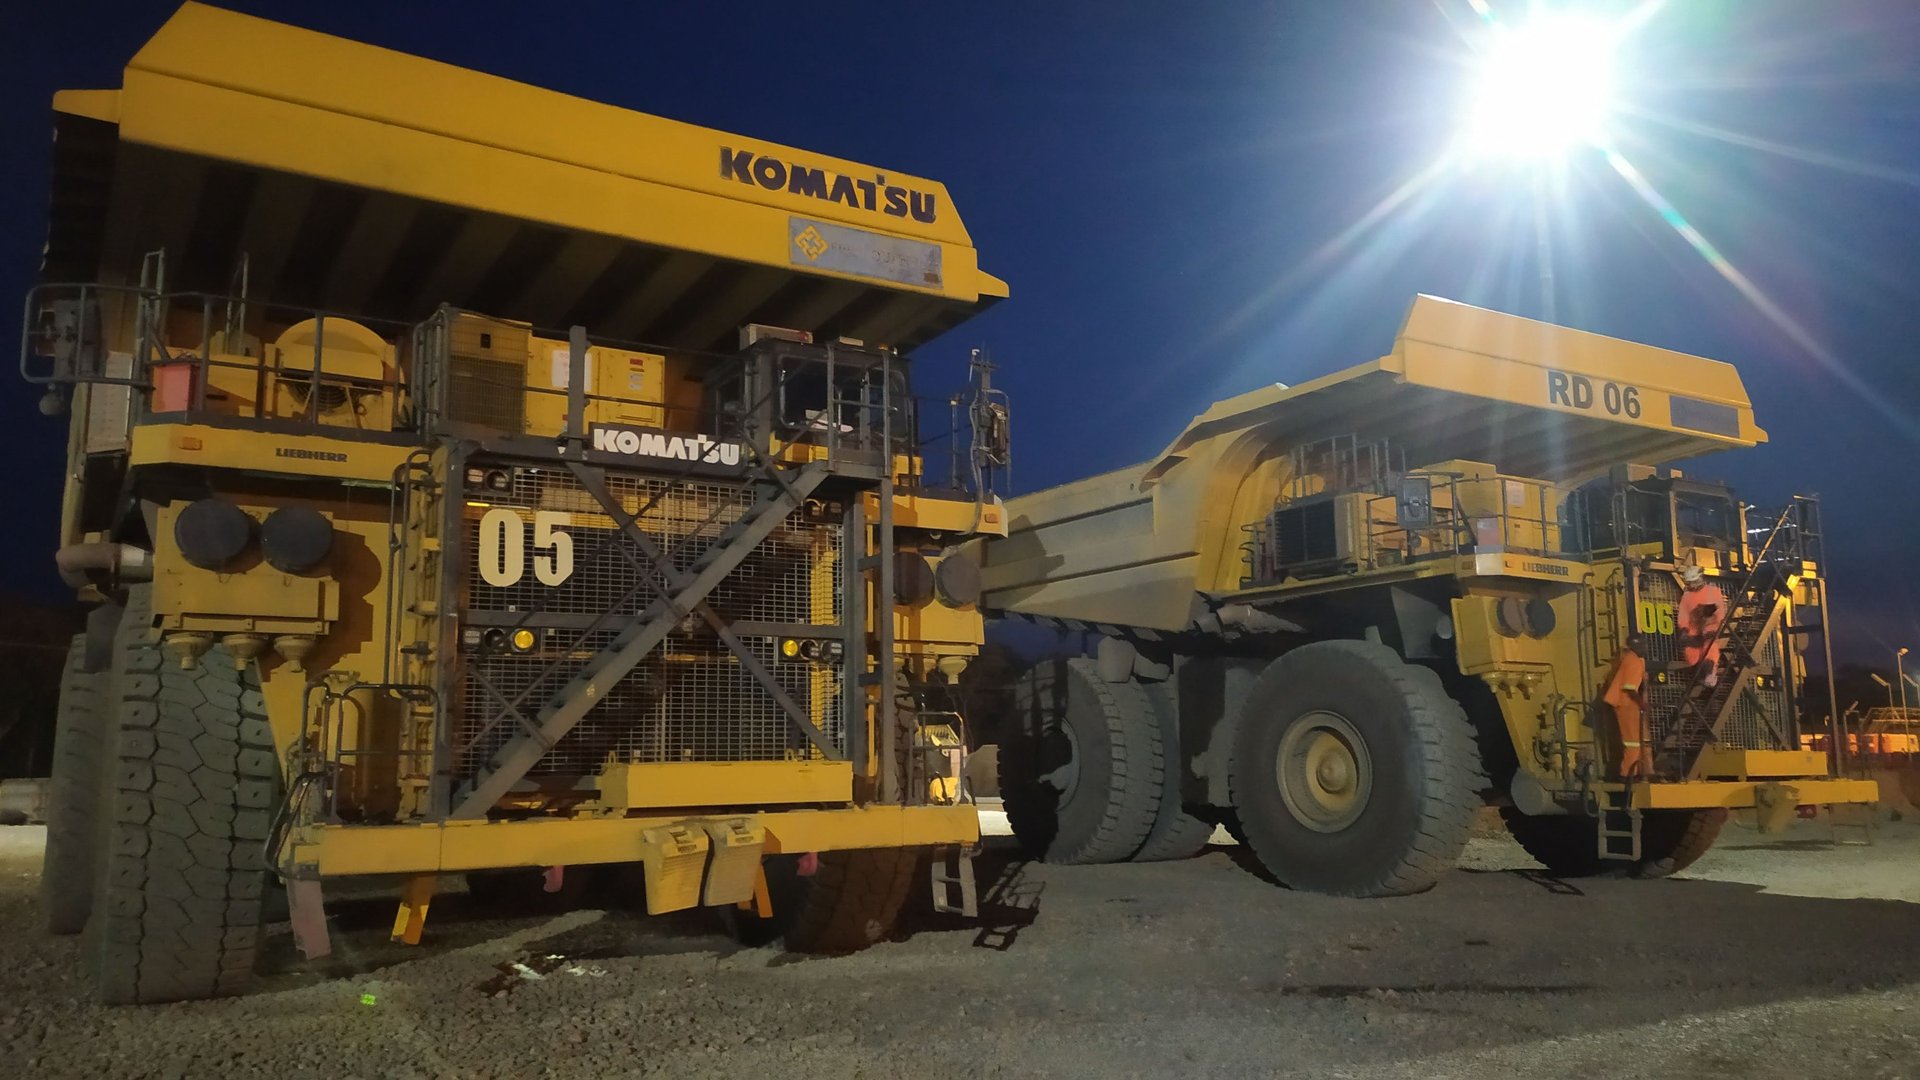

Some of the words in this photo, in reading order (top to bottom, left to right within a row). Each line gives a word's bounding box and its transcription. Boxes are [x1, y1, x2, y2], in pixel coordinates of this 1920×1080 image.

[720, 146, 936, 224] KOMATSU
[1549, 371, 1593, 410] RD
[1603, 382, 1641, 419] 06
[275, 447, 348, 463] LIEBHERR
[593, 428, 740, 466] KOMATSU
[478, 508, 574, 587] 05
[1641, 602, 1674, 635] 06
